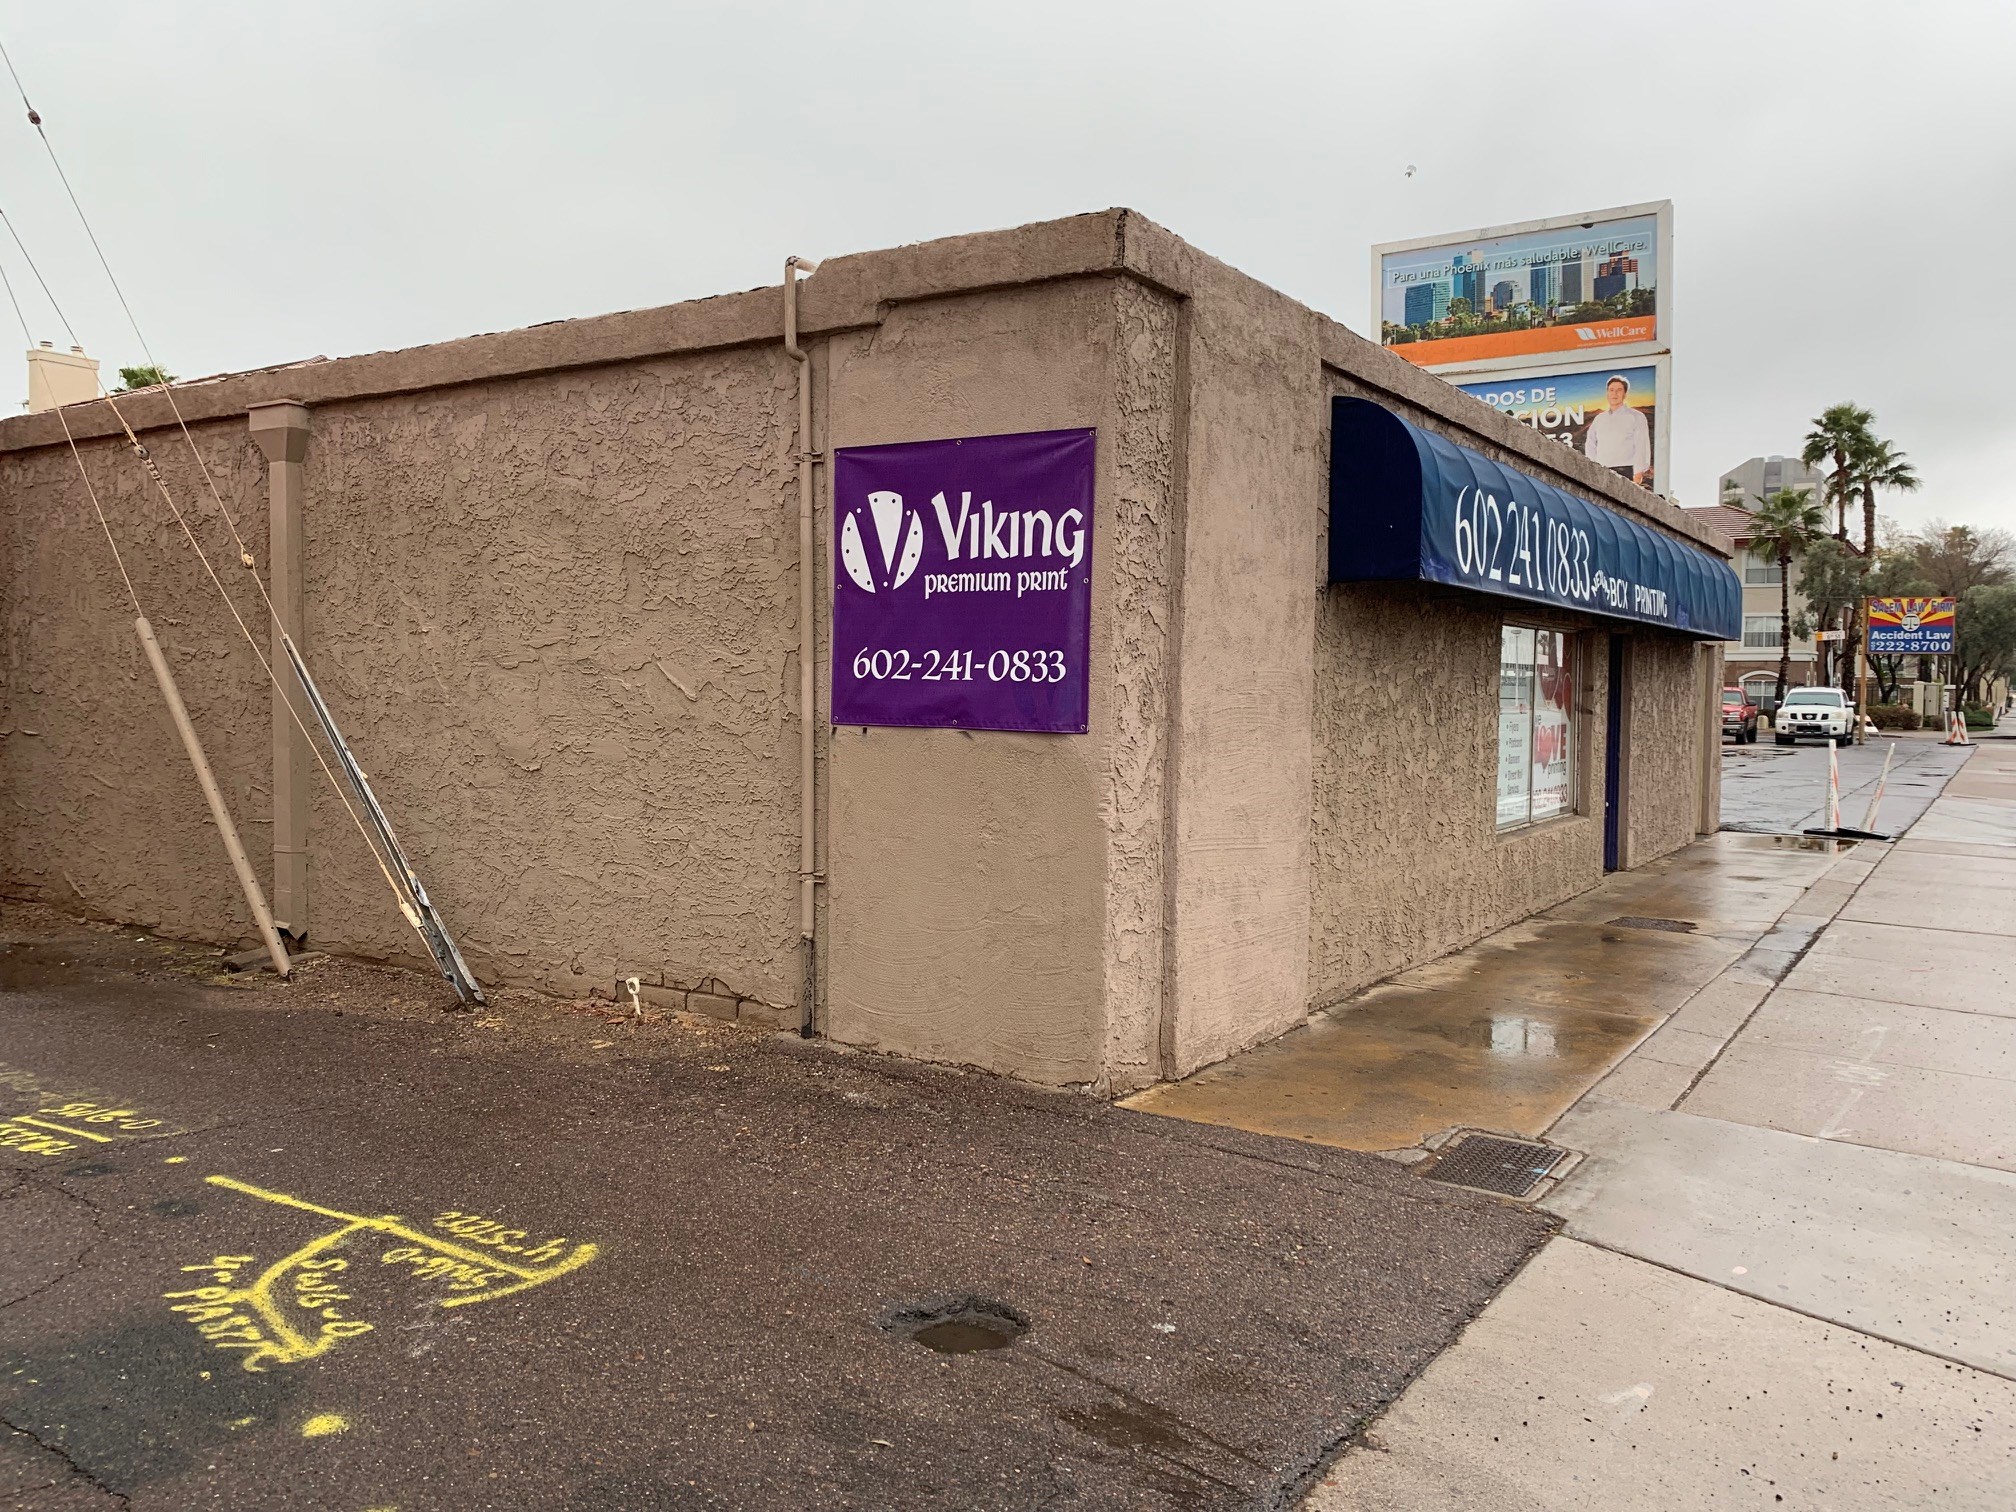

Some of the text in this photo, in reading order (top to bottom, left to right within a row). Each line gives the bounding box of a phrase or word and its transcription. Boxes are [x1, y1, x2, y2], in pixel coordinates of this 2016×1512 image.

[1393, 240, 1648, 283] Para una Phoenix más saludable. WellCare.
[1596, 325, 1648, 339] WellCare
[1531, 387, 1557, 403] DE
[931, 491, 1085, 568] Viking
[1455, 485, 1668, 618] 602 241 0833 BCX PRINTING
[924, 567, 1068, 600] premium print
[1872, 600, 1953, 613] SALEM LAW FIRM
[1871, 631, 1951, 640] Accident Law
[853, 647, 1067, 683] 602-241-0833
